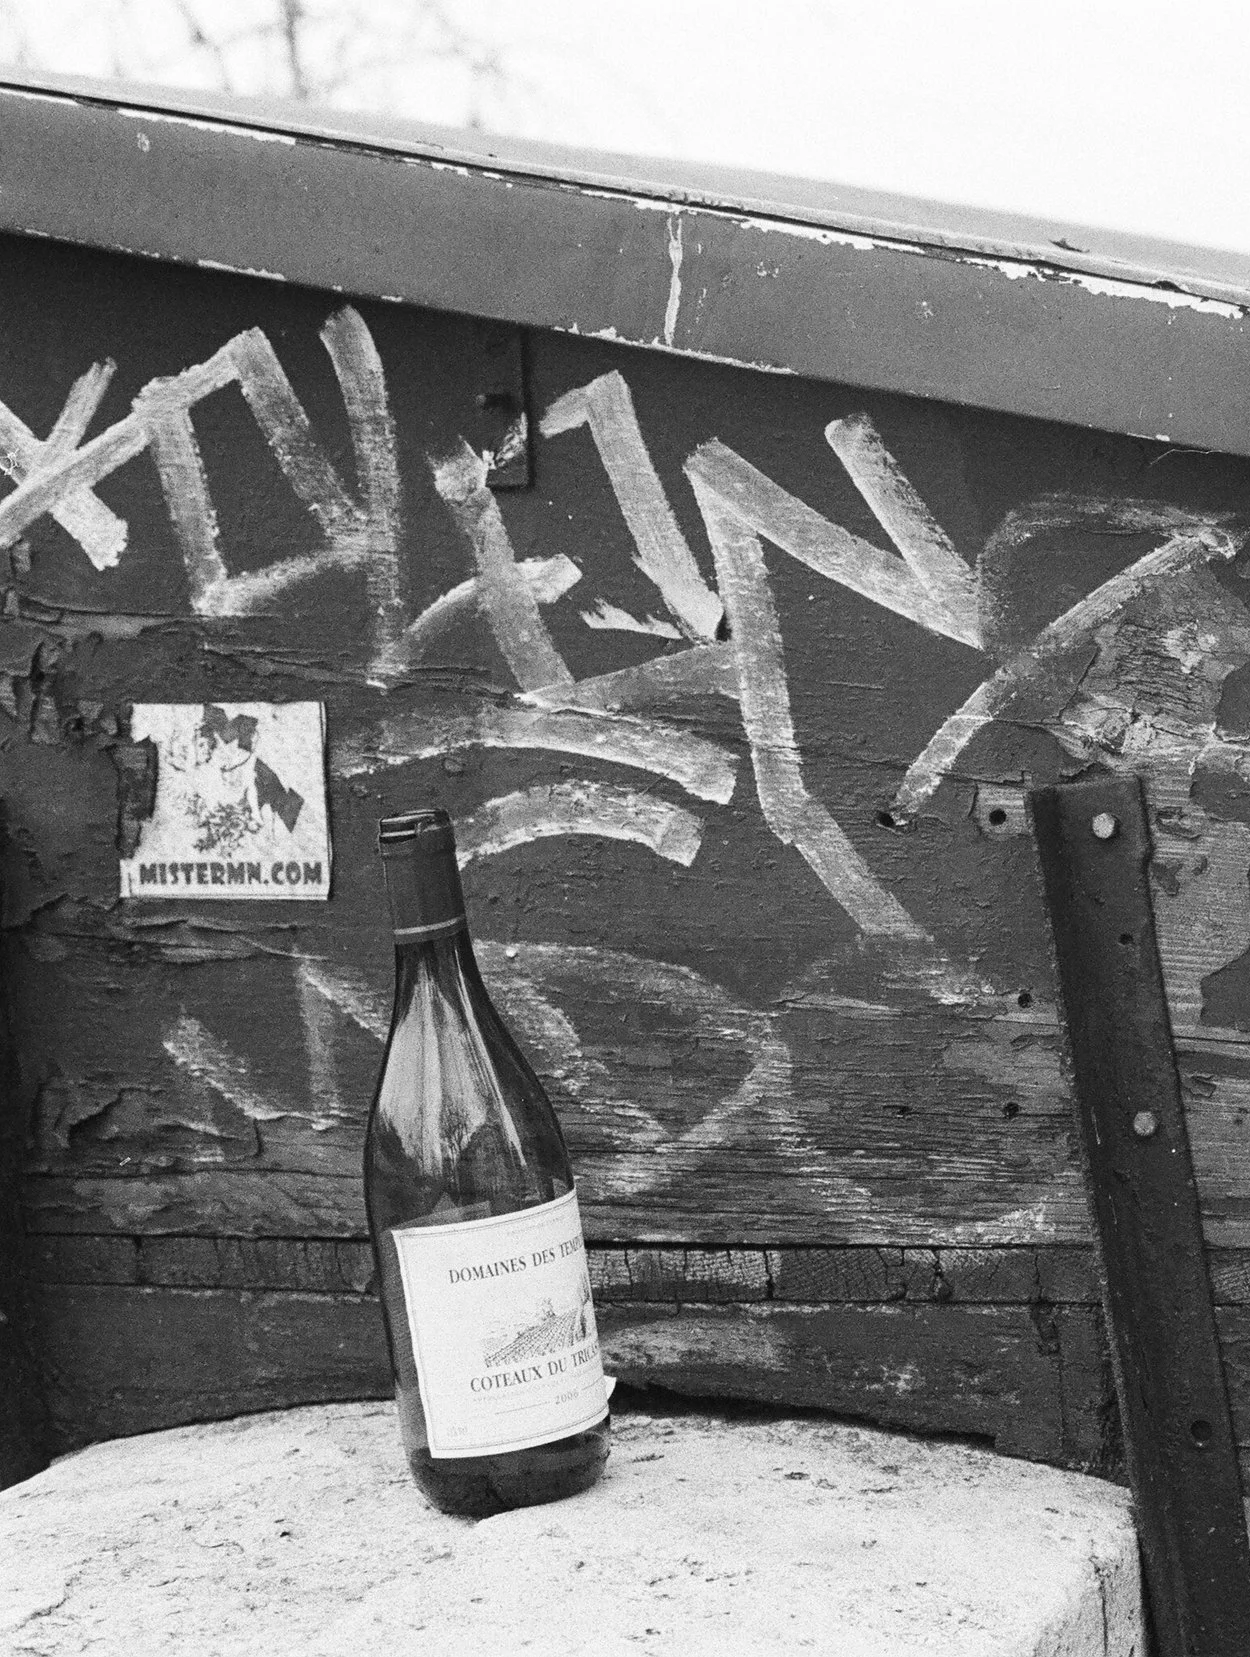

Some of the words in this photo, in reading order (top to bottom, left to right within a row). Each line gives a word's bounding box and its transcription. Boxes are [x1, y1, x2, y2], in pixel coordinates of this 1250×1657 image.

[139, 861, 323, 886] MISTERMN.COM
[448, 1255, 527, 1284] DOMAINES
[532, 1247, 556, 1268] DES
[470, 1365, 543, 1393] COTEAUX
[547, 1357, 568, 1376] DU
